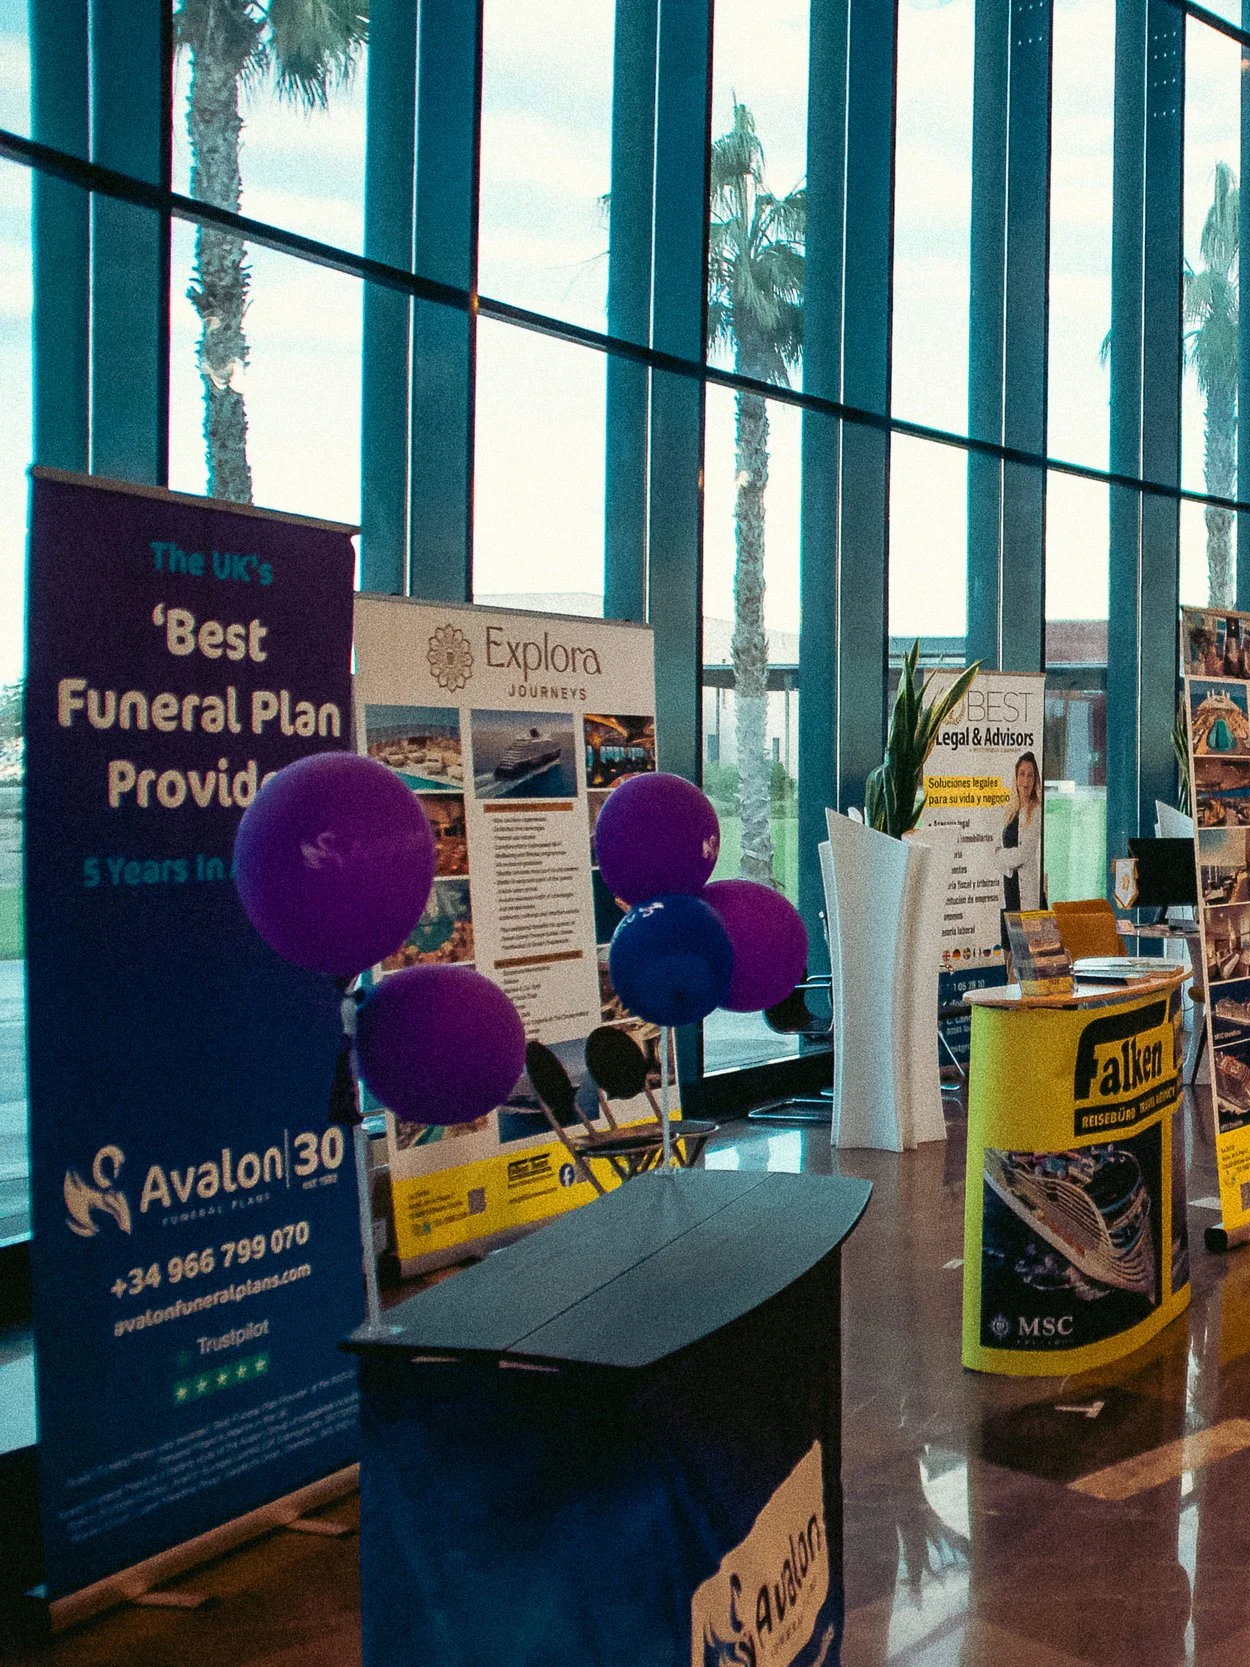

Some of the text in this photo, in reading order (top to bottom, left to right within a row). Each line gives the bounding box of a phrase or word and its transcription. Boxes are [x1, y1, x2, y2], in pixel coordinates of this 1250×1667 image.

[151, 541, 273, 586] The UK's
[485, 625, 602, 683] Explora
[57, 677, 342, 738] Funeral Plan
[508, 684, 588, 701] JOURNEYS
[966, 690, 1034, 723] BEST
[935, 727, 1034, 751] Legal & Advisors
[927, 776, 998, 790] Soluciones legales
[928, 791, 1010, 807] para su vida y negocio
[83, 856, 100, 888] 5
[107, 855, 189, 886] Years
[1082, 1106, 1136, 1129] REISEBÜRO
[139, 1126, 344, 1214] Avalon 30
[110, 1220, 310, 1299] +34 966 799 070
[113, 1263, 312, 1338] avalonfuneralplans.com
[197, 1318, 270, 1356] Trustpilot
[1018, 1315, 1074, 1337] MSC
[754, 1513, 822, 1650] Avalon
